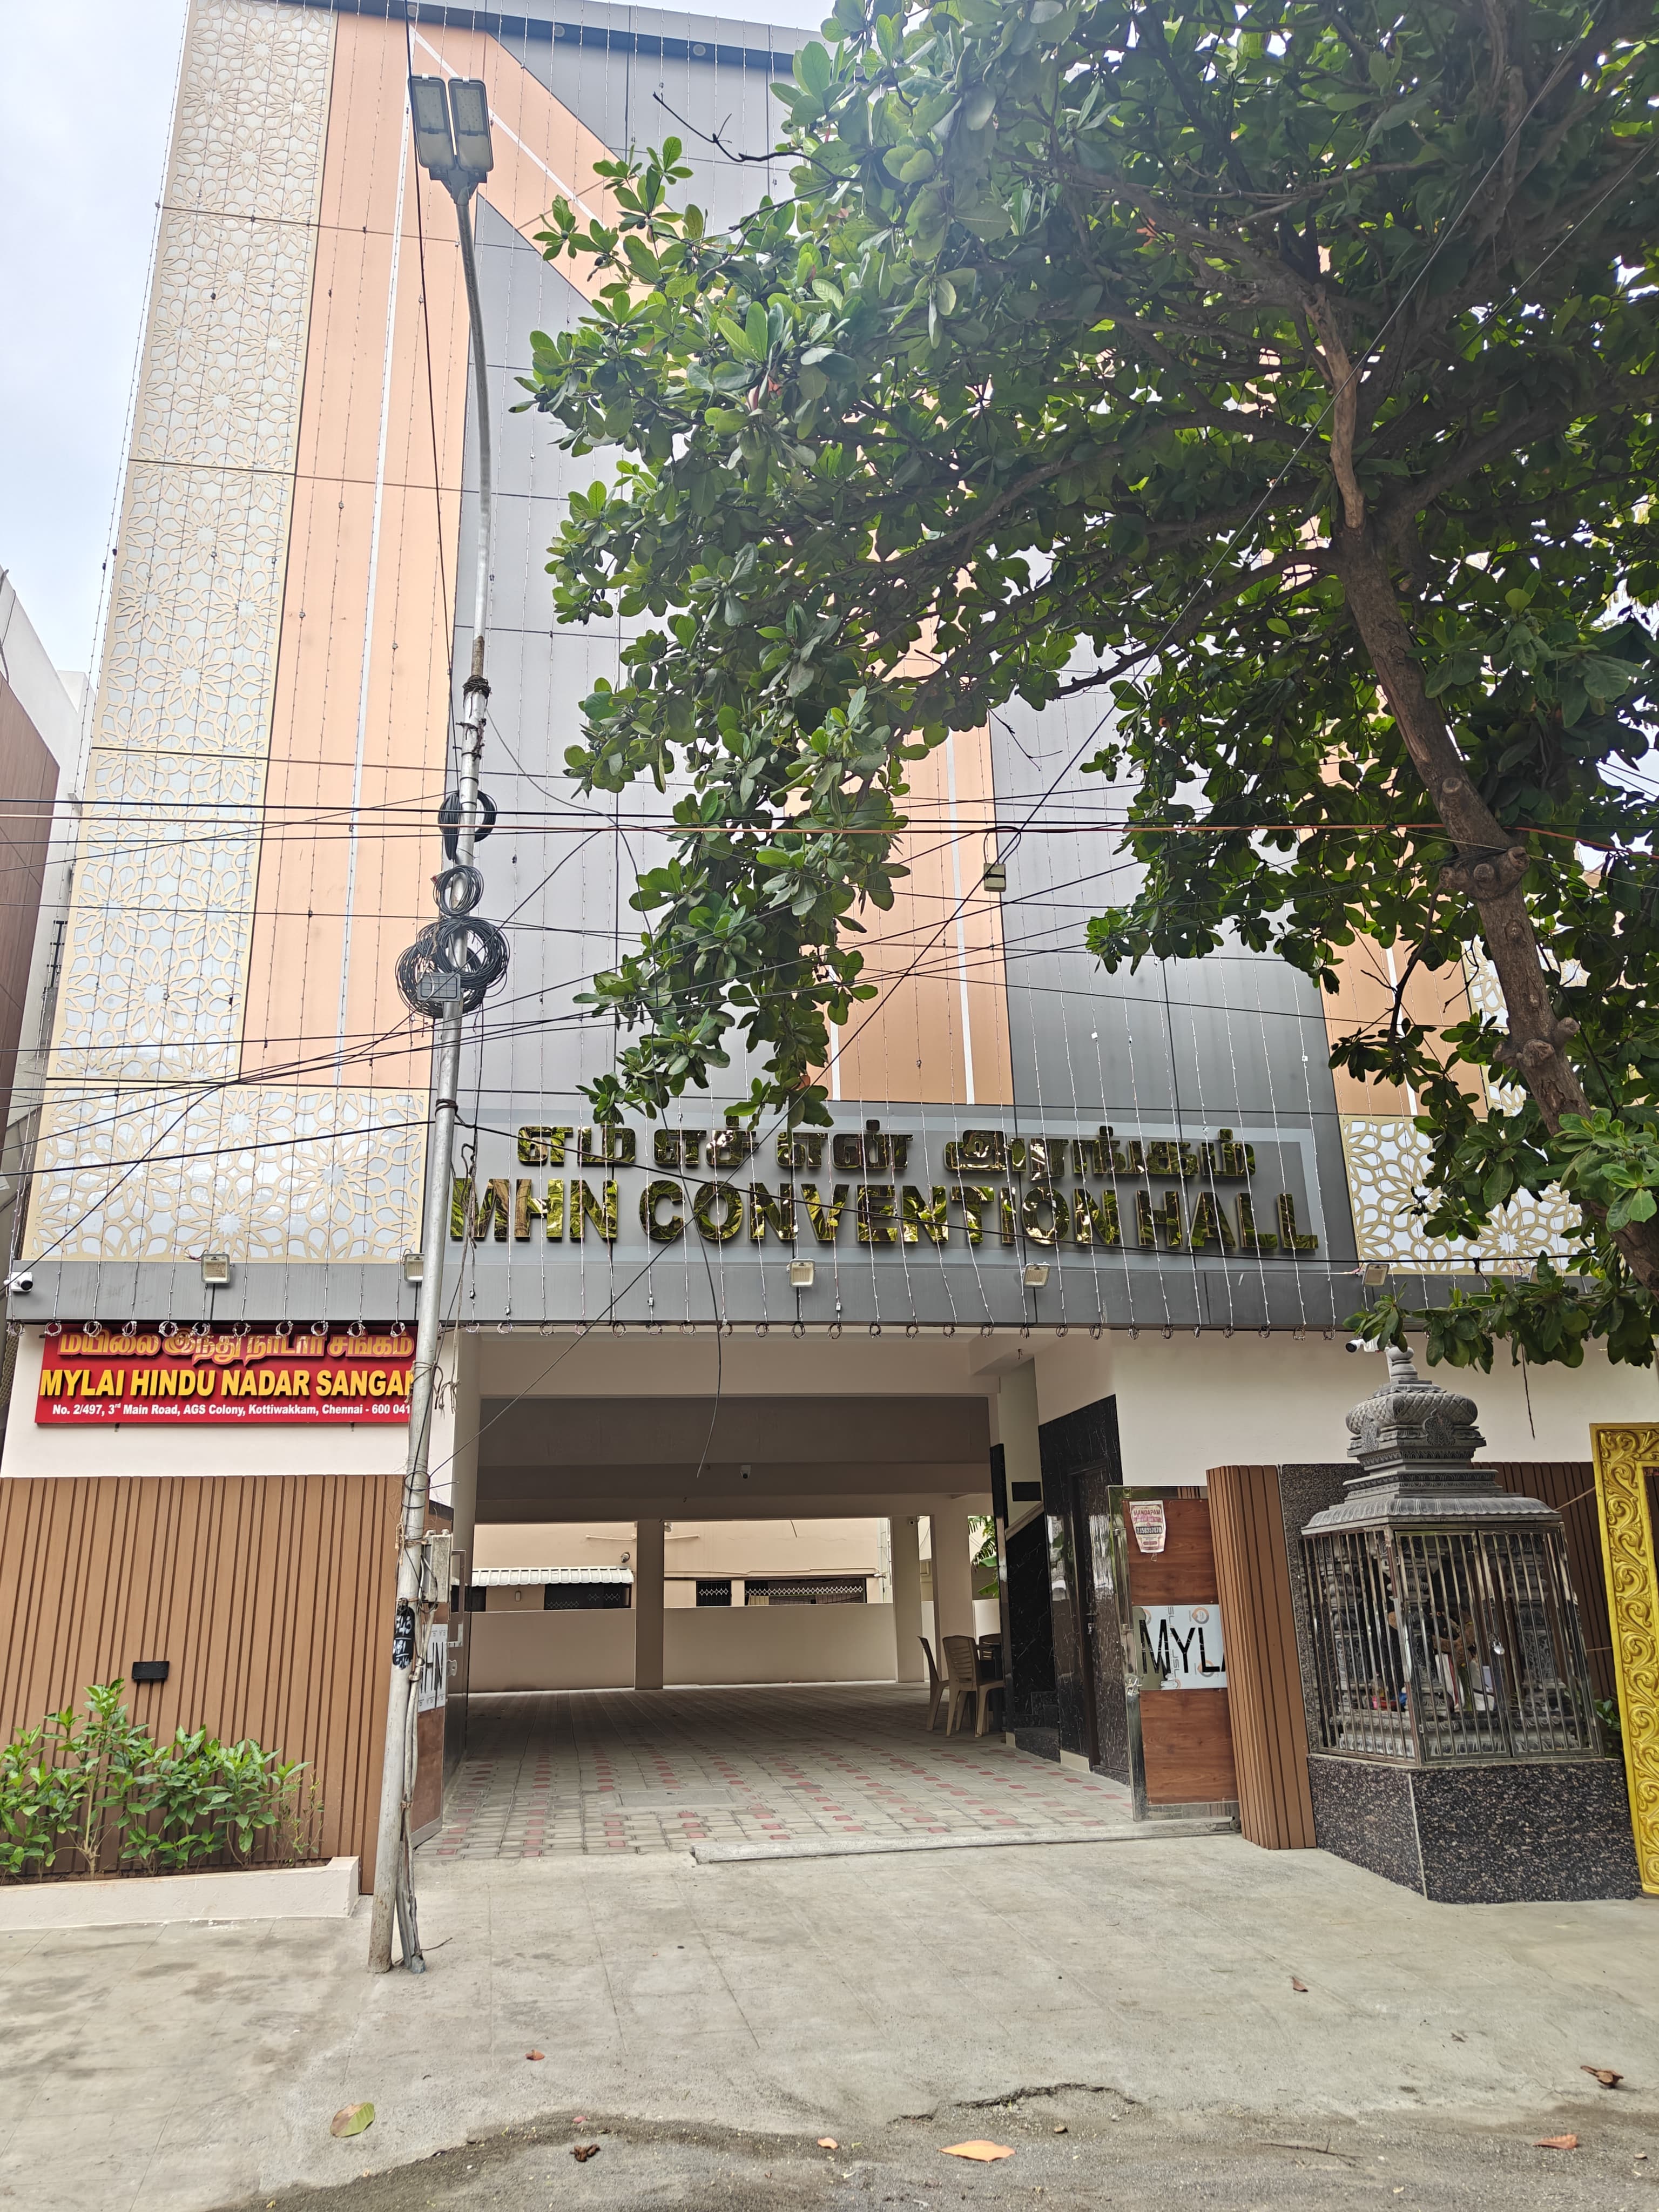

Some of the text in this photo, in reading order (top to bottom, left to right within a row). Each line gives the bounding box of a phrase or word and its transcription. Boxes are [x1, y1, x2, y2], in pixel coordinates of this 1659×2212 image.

[943, 1125, 1256, 1181] அரங்கம்
[450, 1177, 1319, 1250] MHN CONVENTION HALL
[39, 1369, 125, 1397] MYLAI
[130, 1369, 217, 1397] HINDU
[220, 1370, 310, 1397] NADAR
[52, 1404, 70, 1415] No.
[73, 1404, 105, 1417] 2/497,
[123, 1405, 149, 1415] Main
[151, 1404, 181, 1417] Road,
[183, 1404, 206, 1415] AGS
[208, 1404, 246, 1417] Colony,
[248, 1404, 319, 1417] Kottiwakkam,
[322, 1404, 363, 1414] Chennai
[372, 1404, 391, 1414] 600
[393, 1404, 410, 1414] 041
